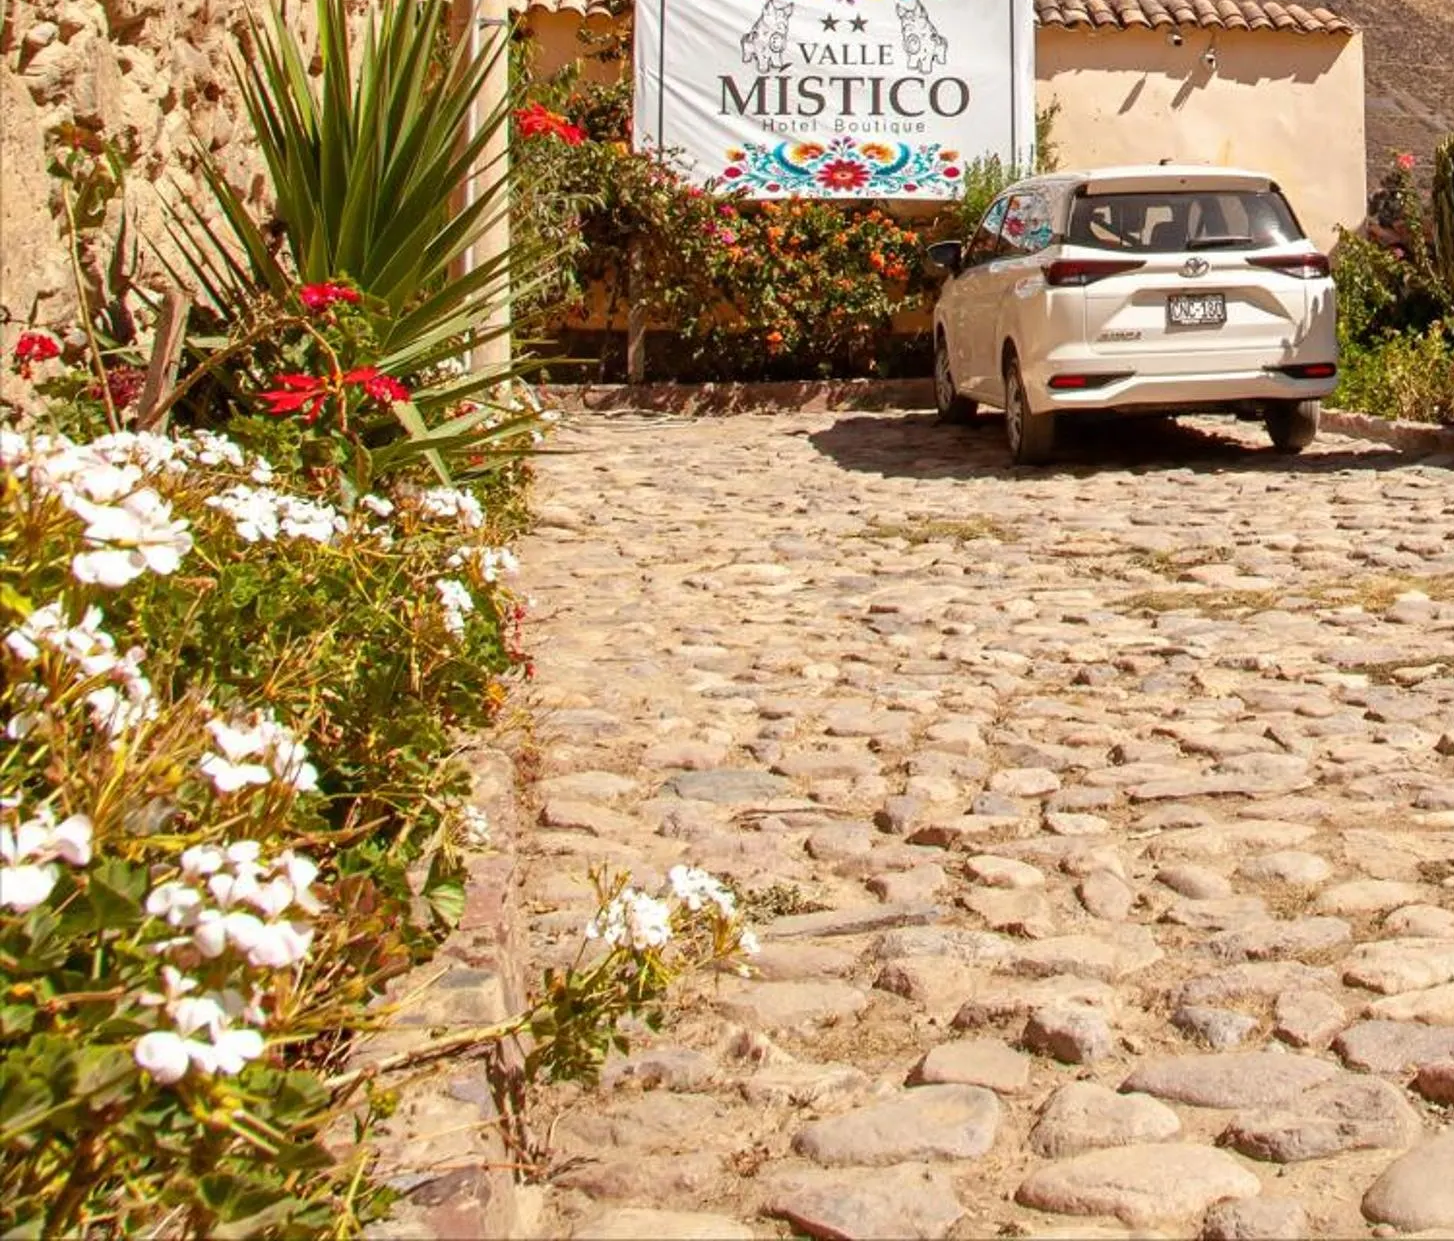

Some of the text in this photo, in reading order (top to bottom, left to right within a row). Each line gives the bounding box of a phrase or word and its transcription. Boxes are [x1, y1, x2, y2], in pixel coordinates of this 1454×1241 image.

[797, 42, 894, 66] VALLE
[717, 62, 971, 118] MÍSTICO
[762, 117, 926, 135] Hotel Boutique
